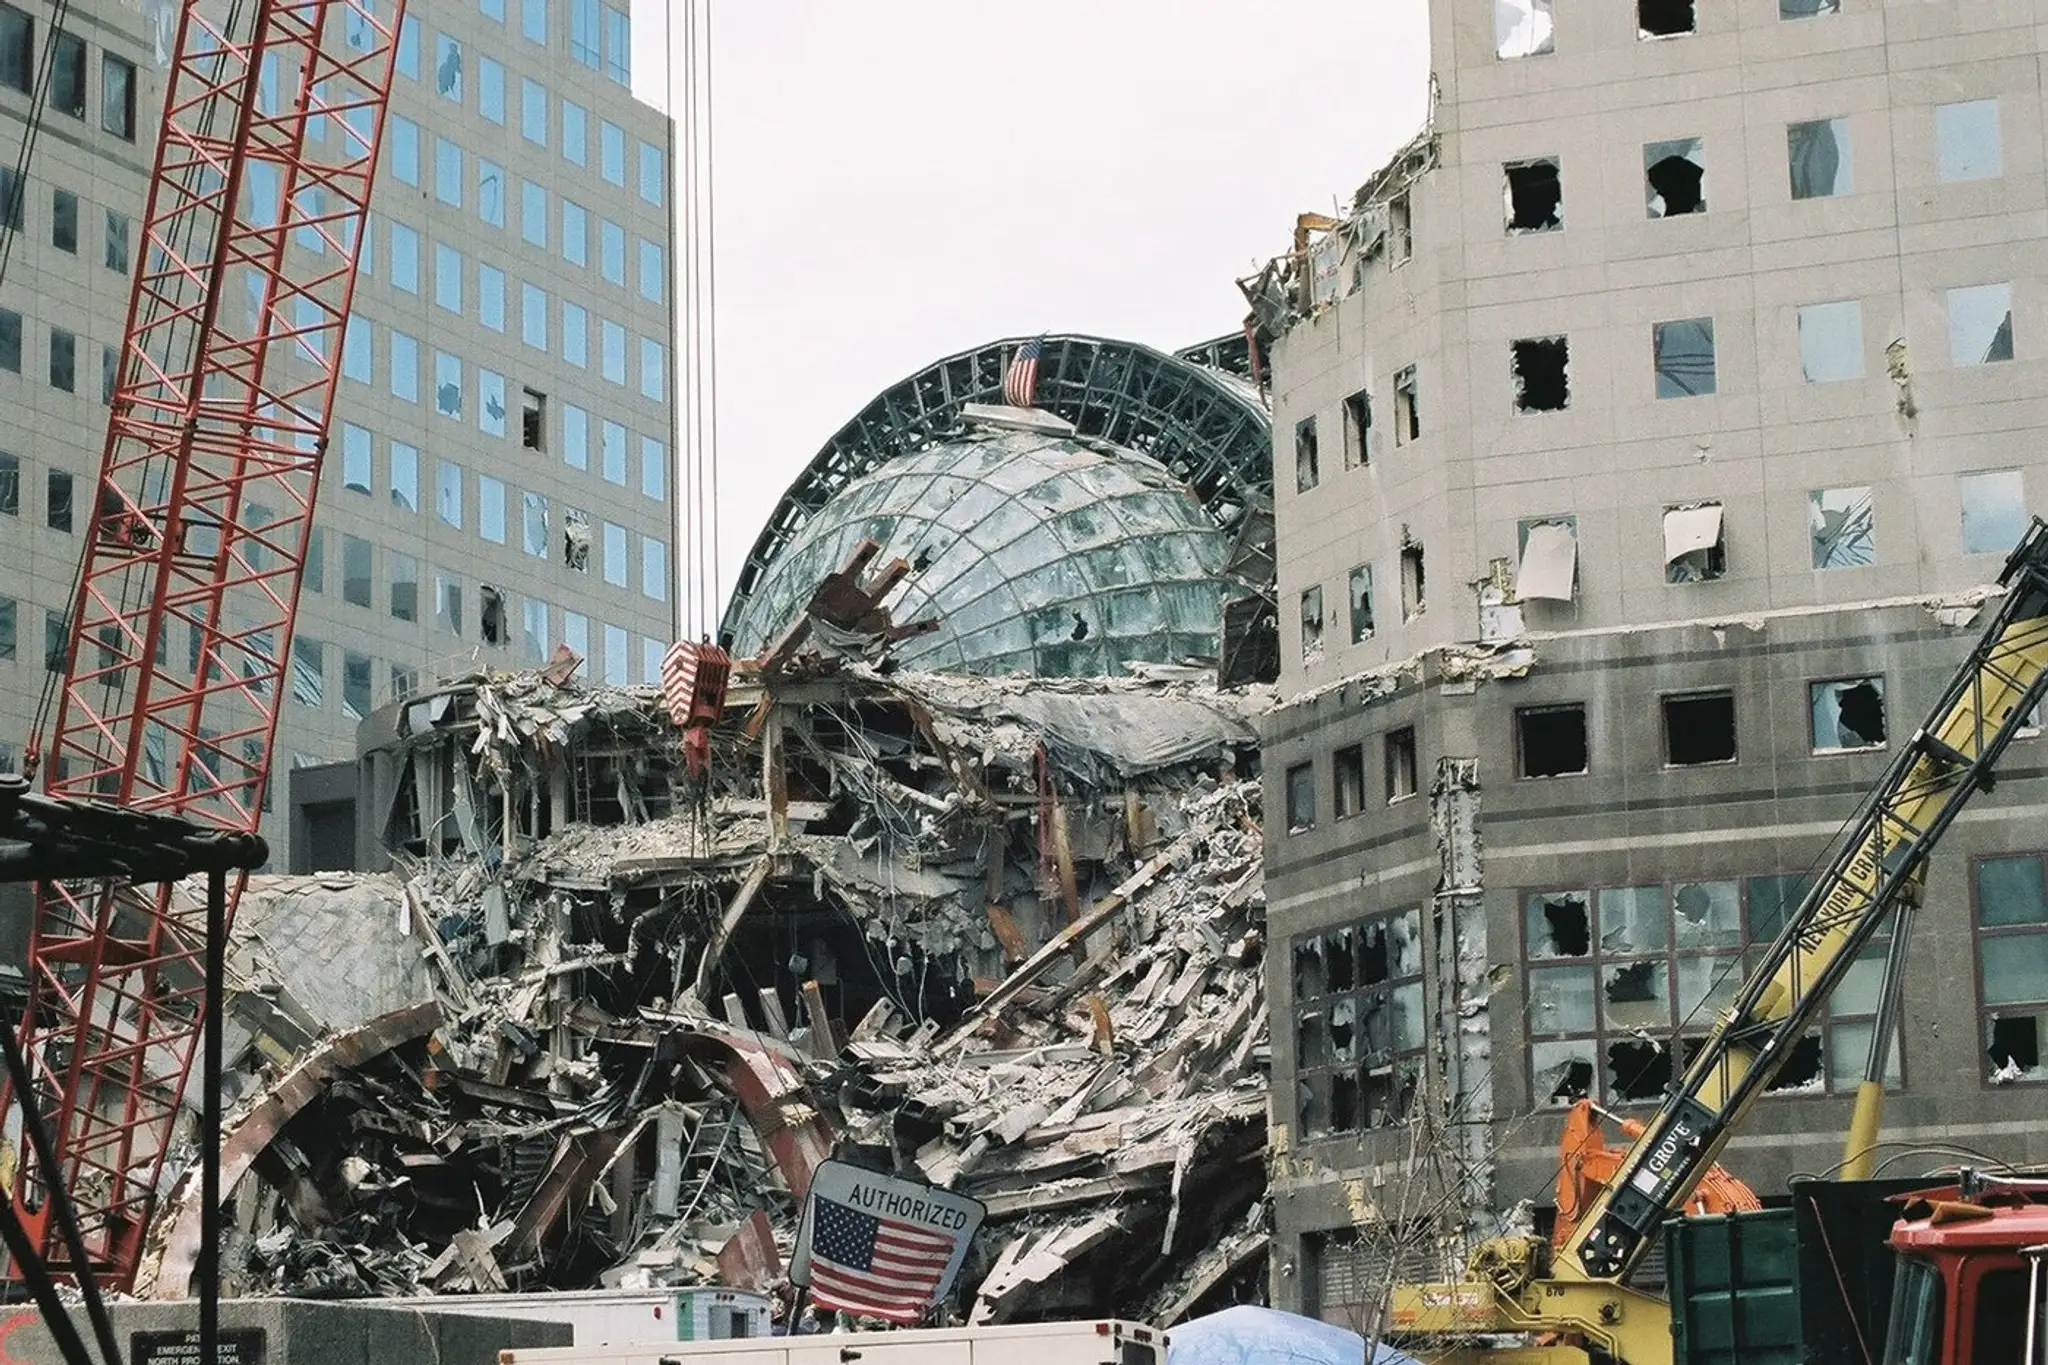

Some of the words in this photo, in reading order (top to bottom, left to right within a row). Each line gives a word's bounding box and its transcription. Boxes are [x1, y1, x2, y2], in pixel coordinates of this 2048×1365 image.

[1820, 880, 1858, 920] YORK
[1648, 1120, 1691, 1172] GROVE
[848, 1184, 967, 1230] AUTHORIZED
[147, 1357, 179, 1365] NORTH
[157, 1345, 200, 1356] EMERGEN
[216, 1343, 237, 1354] EXIT
